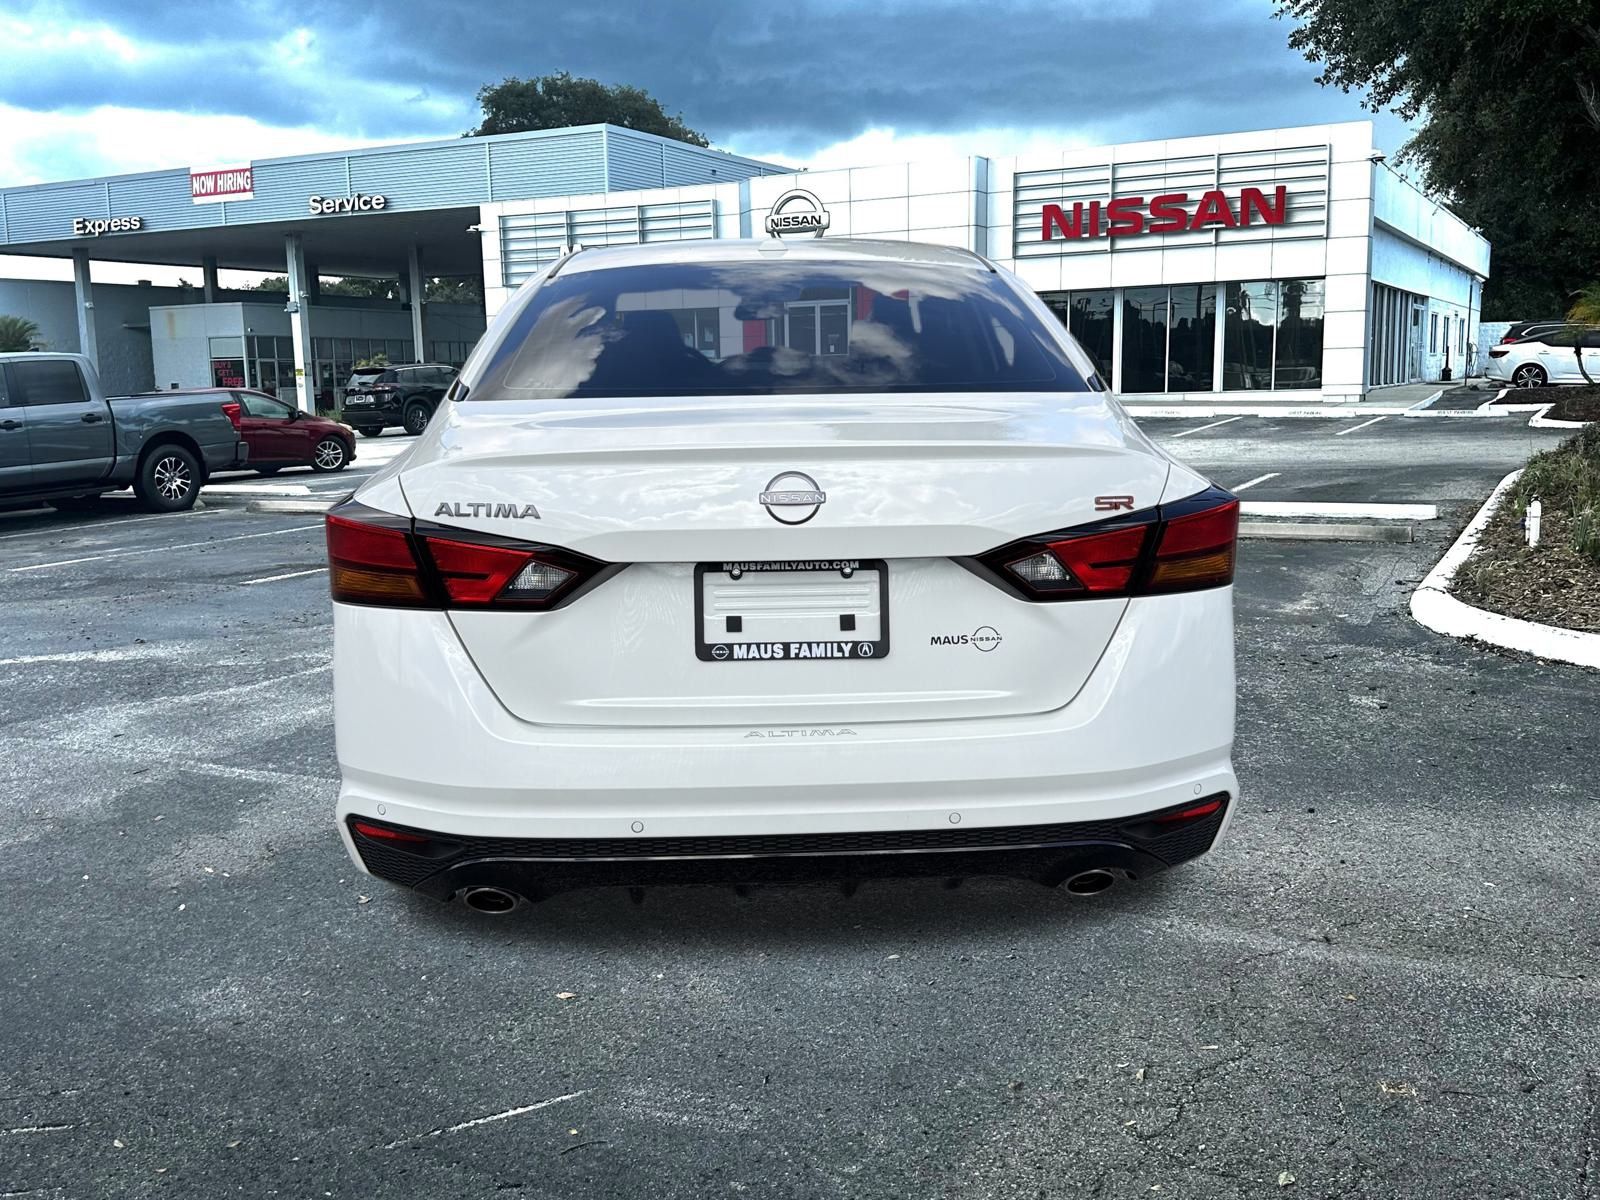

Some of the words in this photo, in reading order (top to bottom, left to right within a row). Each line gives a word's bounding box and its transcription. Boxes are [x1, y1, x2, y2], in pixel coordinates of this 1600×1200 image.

[192, 174, 215, 195] NOW
[217, 170, 251, 192] HIRING
[308, 193, 386, 215] Service
[770, 215, 821, 228] NISSAN
[1041, 186, 1287, 241] NISSAN
[73, 215, 142, 237] Express
[222, 377, 244, 386] FREE
[761, 494, 825, 503] NISSAN
[1094, 495, 1134, 511] SR
[434, 502, 541, 519] ALTIMA
[723, 561, 859, 571] MAUSFAMILYAUTO.COM
[930, 635, 968, 646] MAUS
[733, 643, 785, 659] MAUS
[790, 642, 853, 659] FAMILY
[744, 728, 857, 738] ALTIMA
